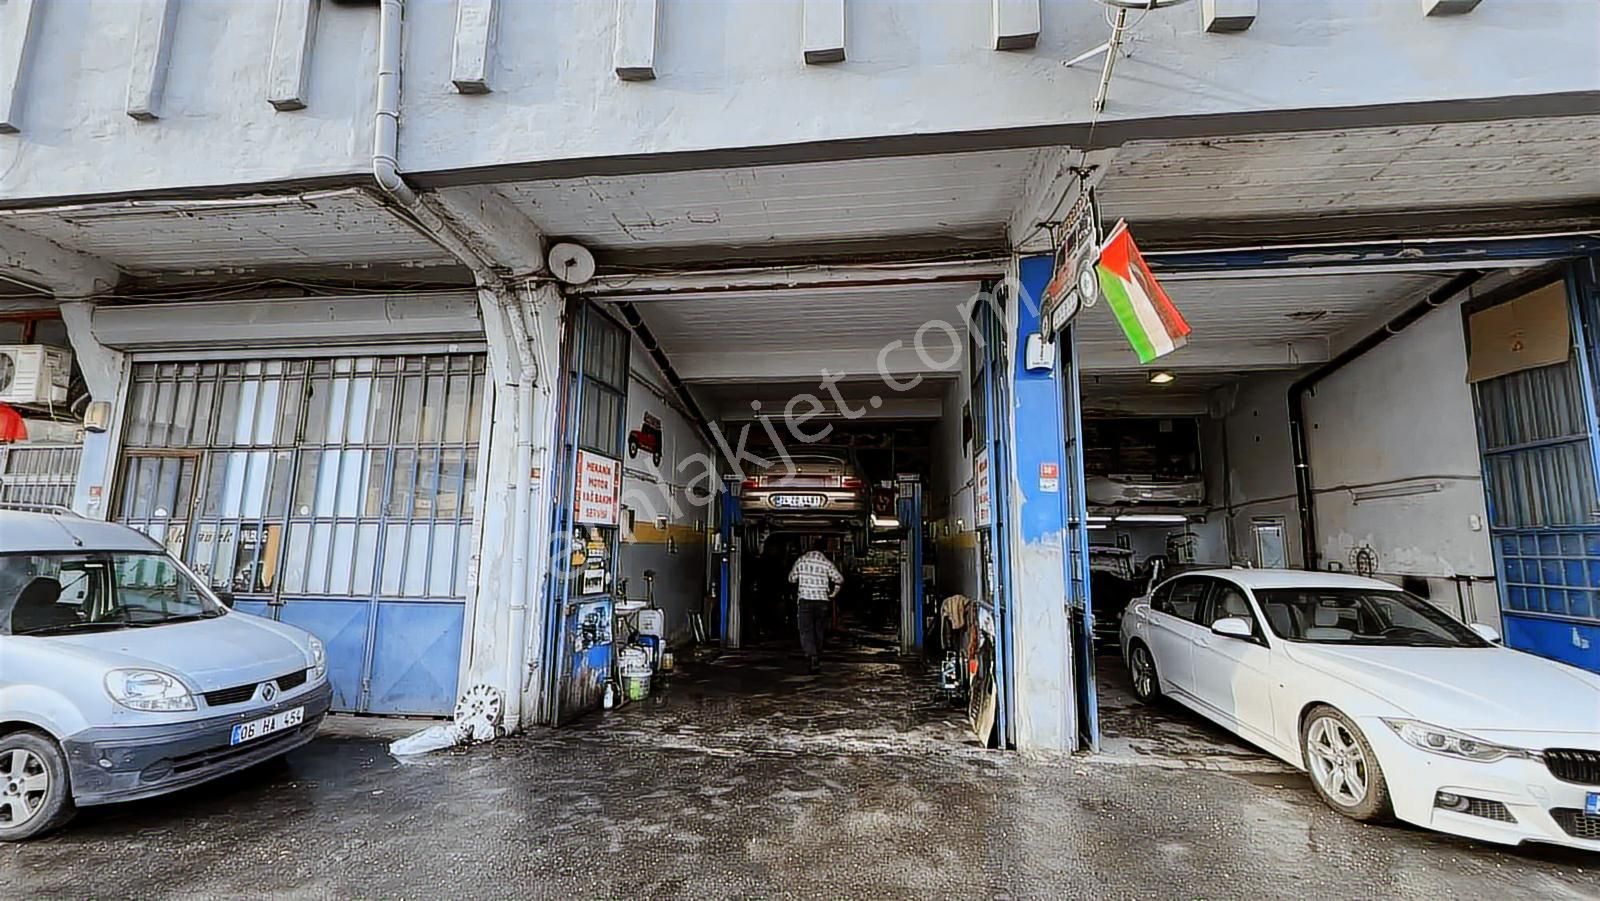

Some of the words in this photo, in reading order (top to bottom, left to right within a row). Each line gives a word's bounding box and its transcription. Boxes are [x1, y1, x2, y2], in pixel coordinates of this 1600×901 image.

[589, 478, 608, 489] MOTOR
[241, 724, 255, 740] 06
[284, 709, 301, 727] 454
